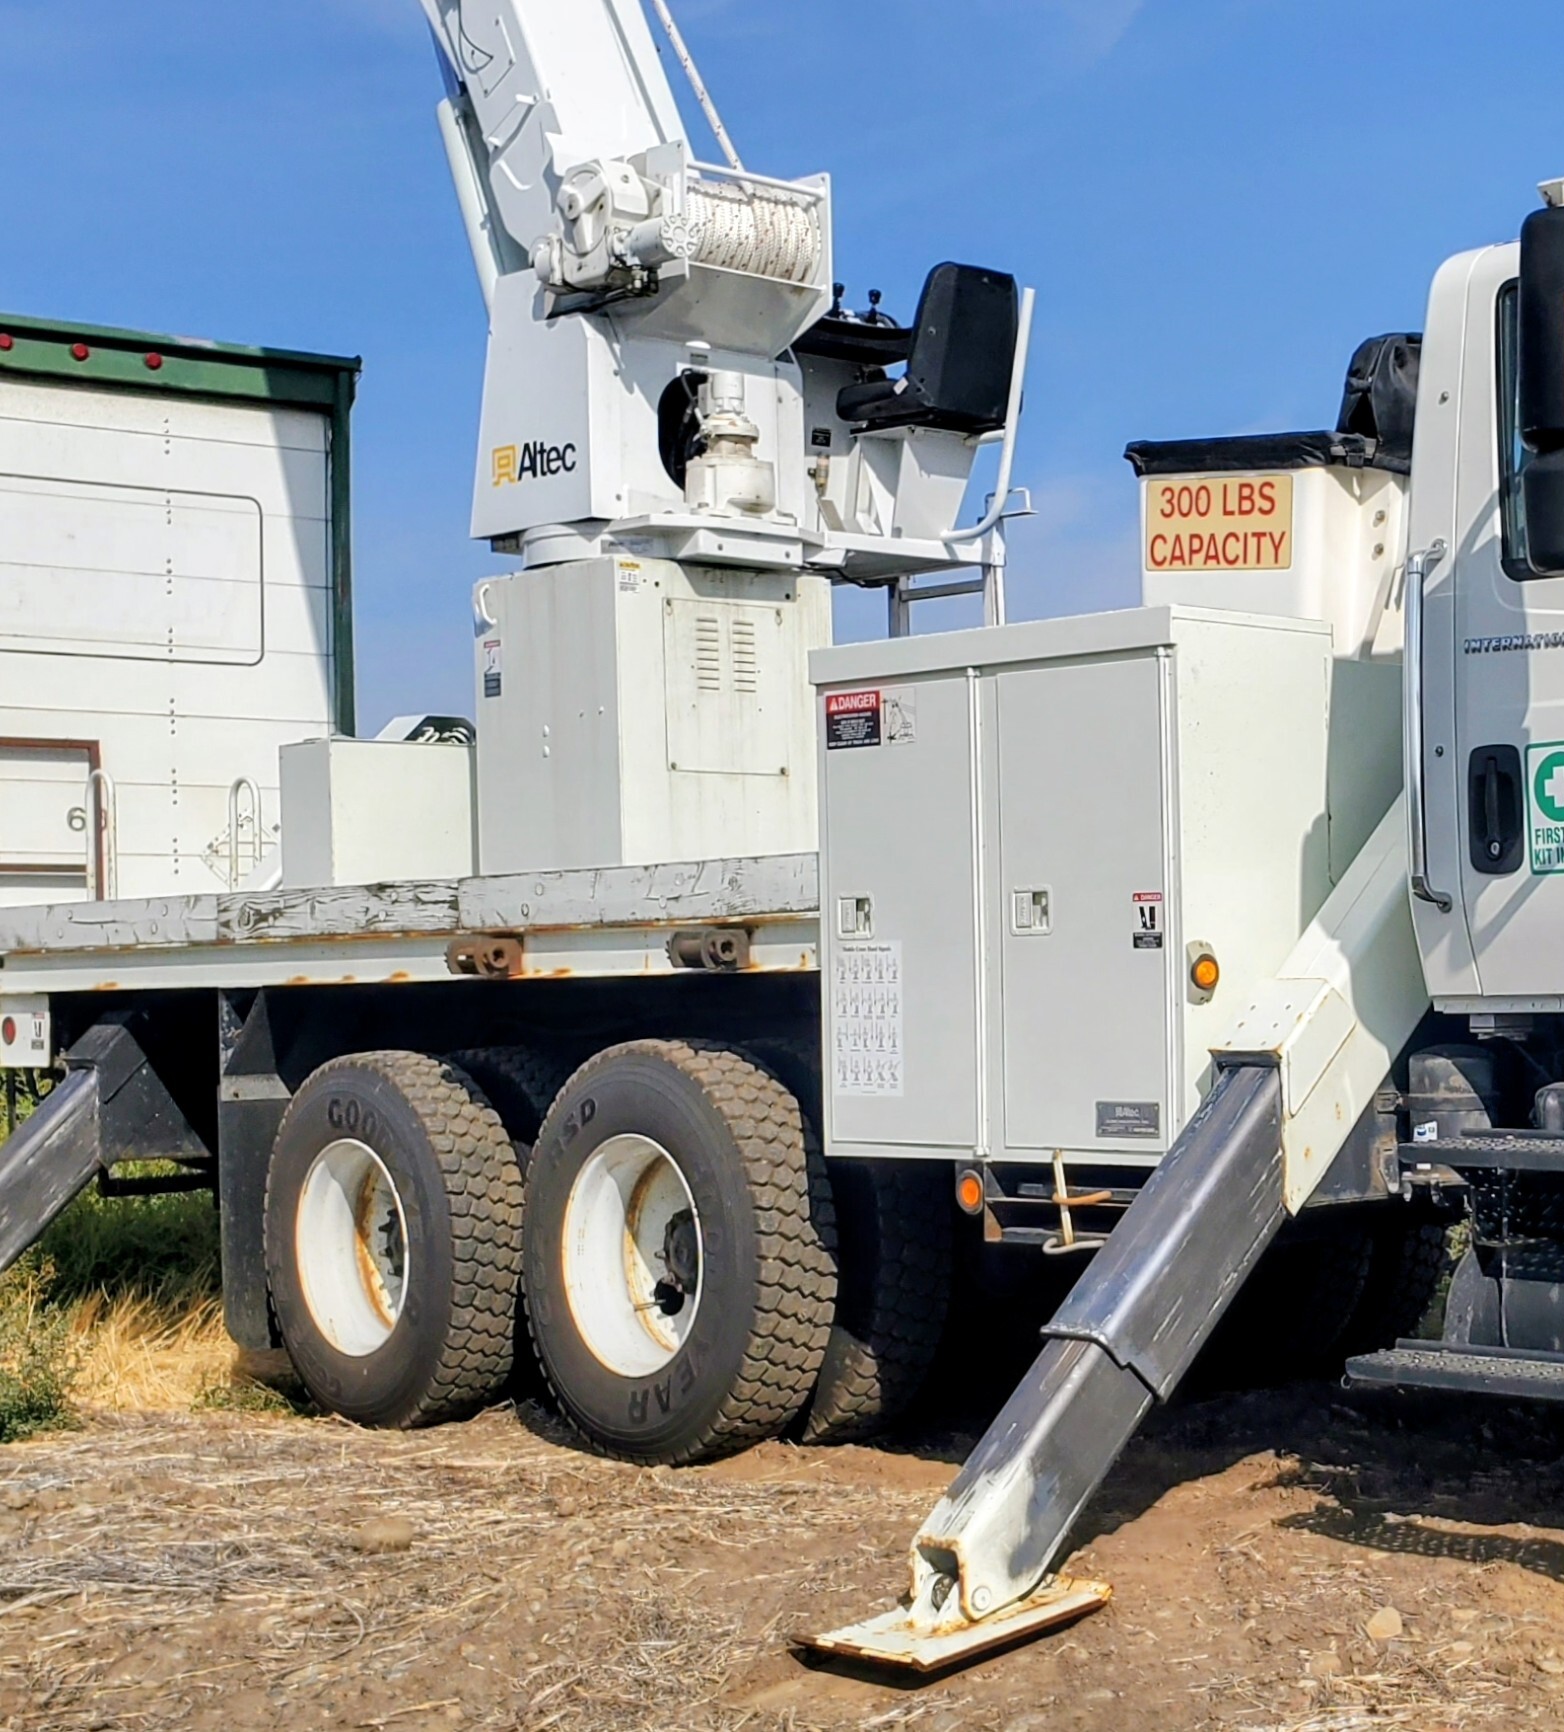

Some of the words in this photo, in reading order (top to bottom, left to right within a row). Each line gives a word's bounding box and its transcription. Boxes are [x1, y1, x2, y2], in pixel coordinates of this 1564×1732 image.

[517, 440, 577, 482] Altec
[1160, 485, 1211, 518] 300
[1222, 481, 1276, 516] LBS
[1150, 531, 1286, 567] CAPACITY
[837, 693, 877, 710] DANGER
[1534, 847, 1553, 866] KIT
